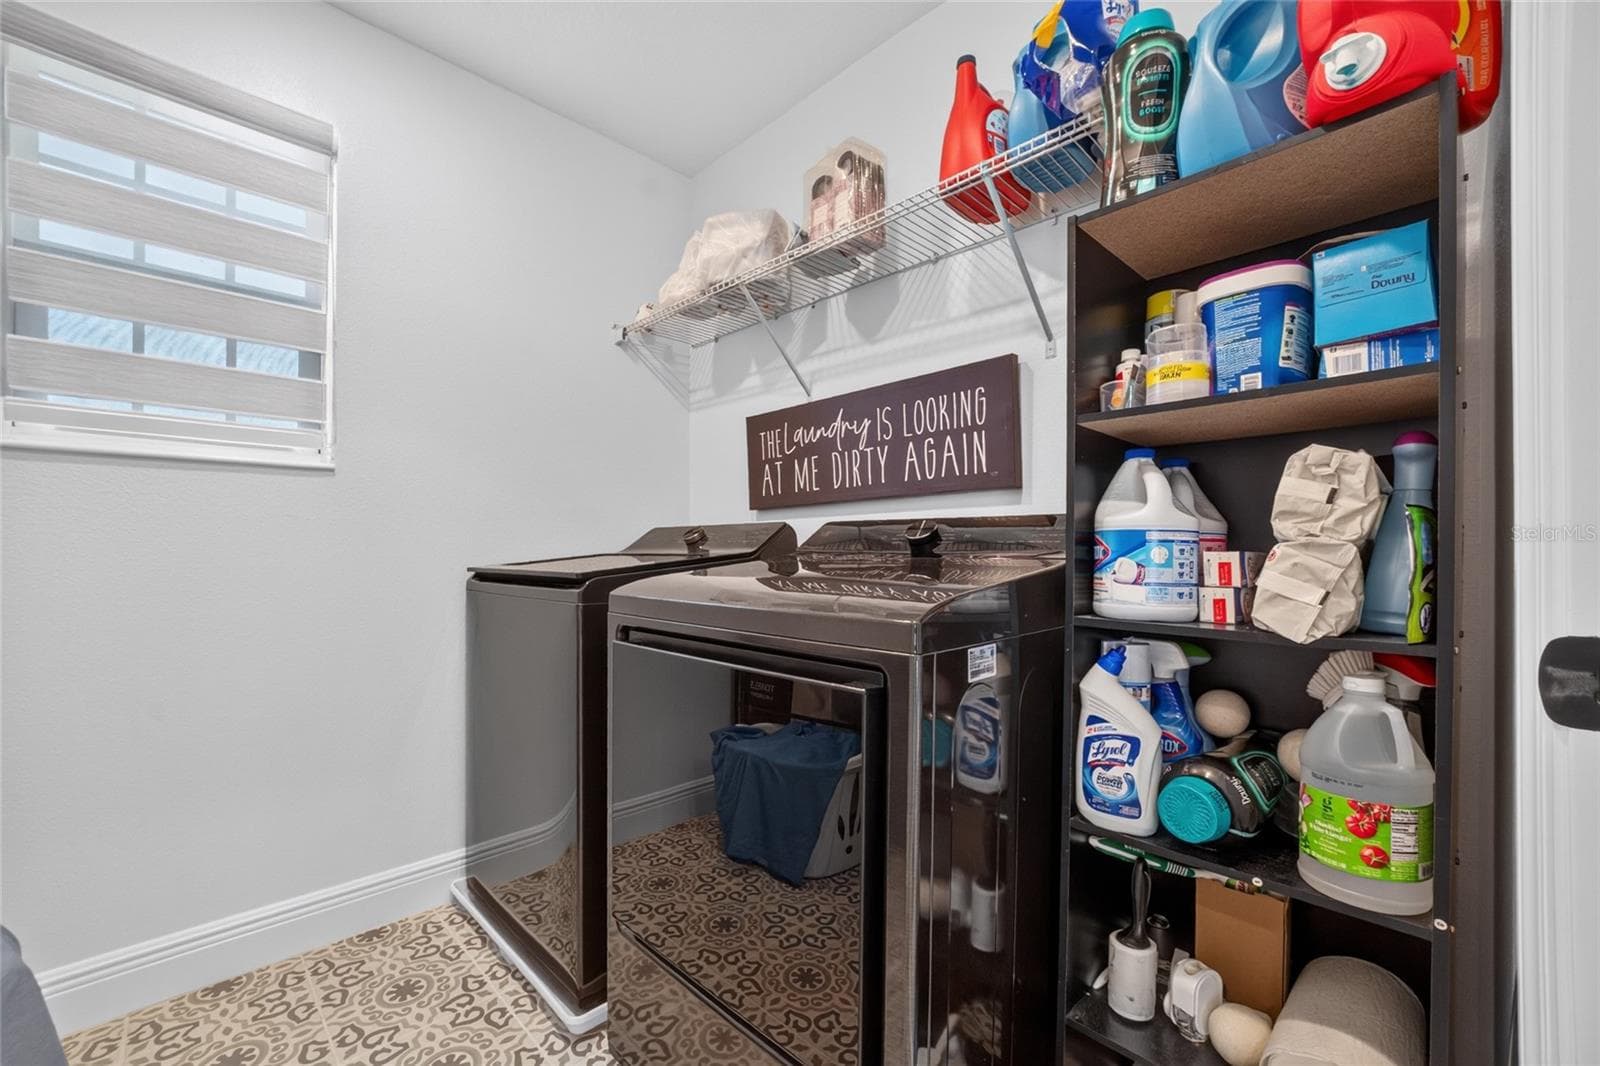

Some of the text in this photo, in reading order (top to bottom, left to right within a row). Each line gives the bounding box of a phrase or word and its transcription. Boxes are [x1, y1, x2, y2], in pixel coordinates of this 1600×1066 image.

[1138, 106, 1165, 117] BOOST
[1370, 272, 1416, 290] Downy
[759, 386, 987, 461] THE Laundry IS LOOKING
[762, 430, 988, 497] AT ME DIRTY AGAIN
[1091, 741, 1128, 759] Lysol
